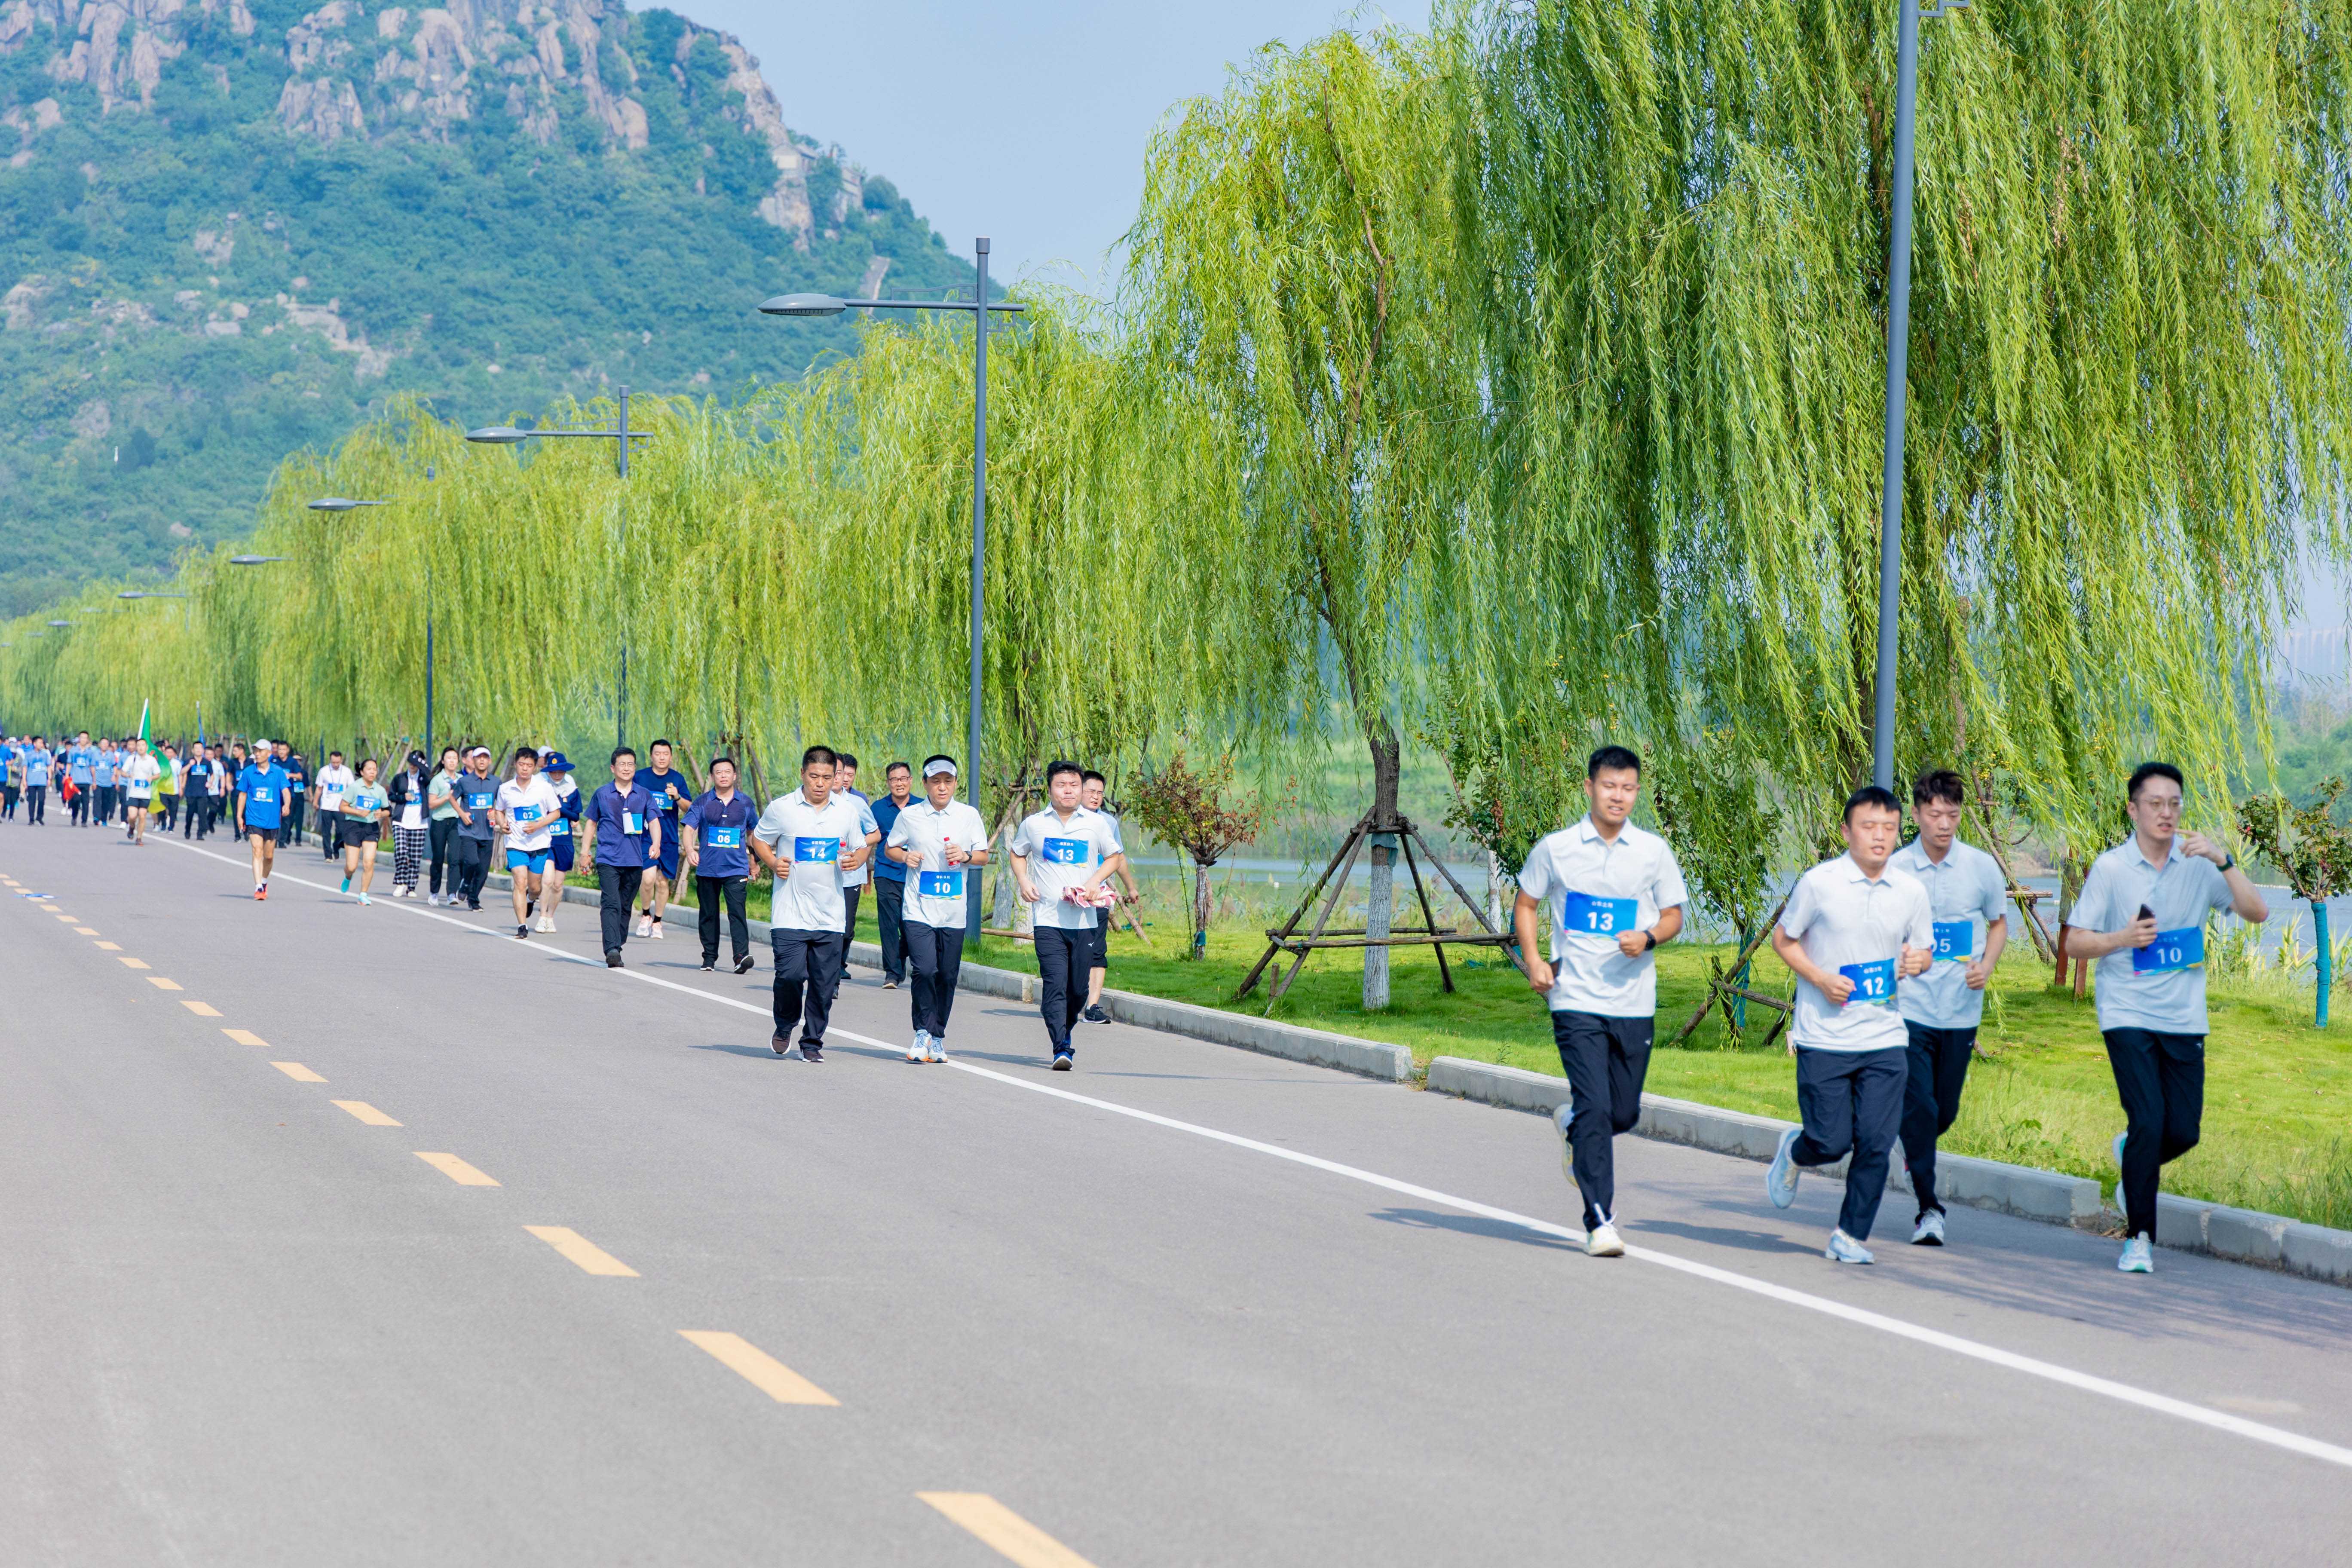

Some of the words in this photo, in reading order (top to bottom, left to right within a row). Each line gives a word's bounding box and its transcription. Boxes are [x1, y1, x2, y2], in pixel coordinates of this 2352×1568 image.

[717, 834, 730, 843] 06
[809, 848, 826, 859] 14
[1058, 849, 1074, 861] 13
[934, 882, 951, 894] 10
[1587, 911, 1614, 931] 13
[2157, 947, 2182, 965] 10
[1862, 976, 1884, 996] 12
